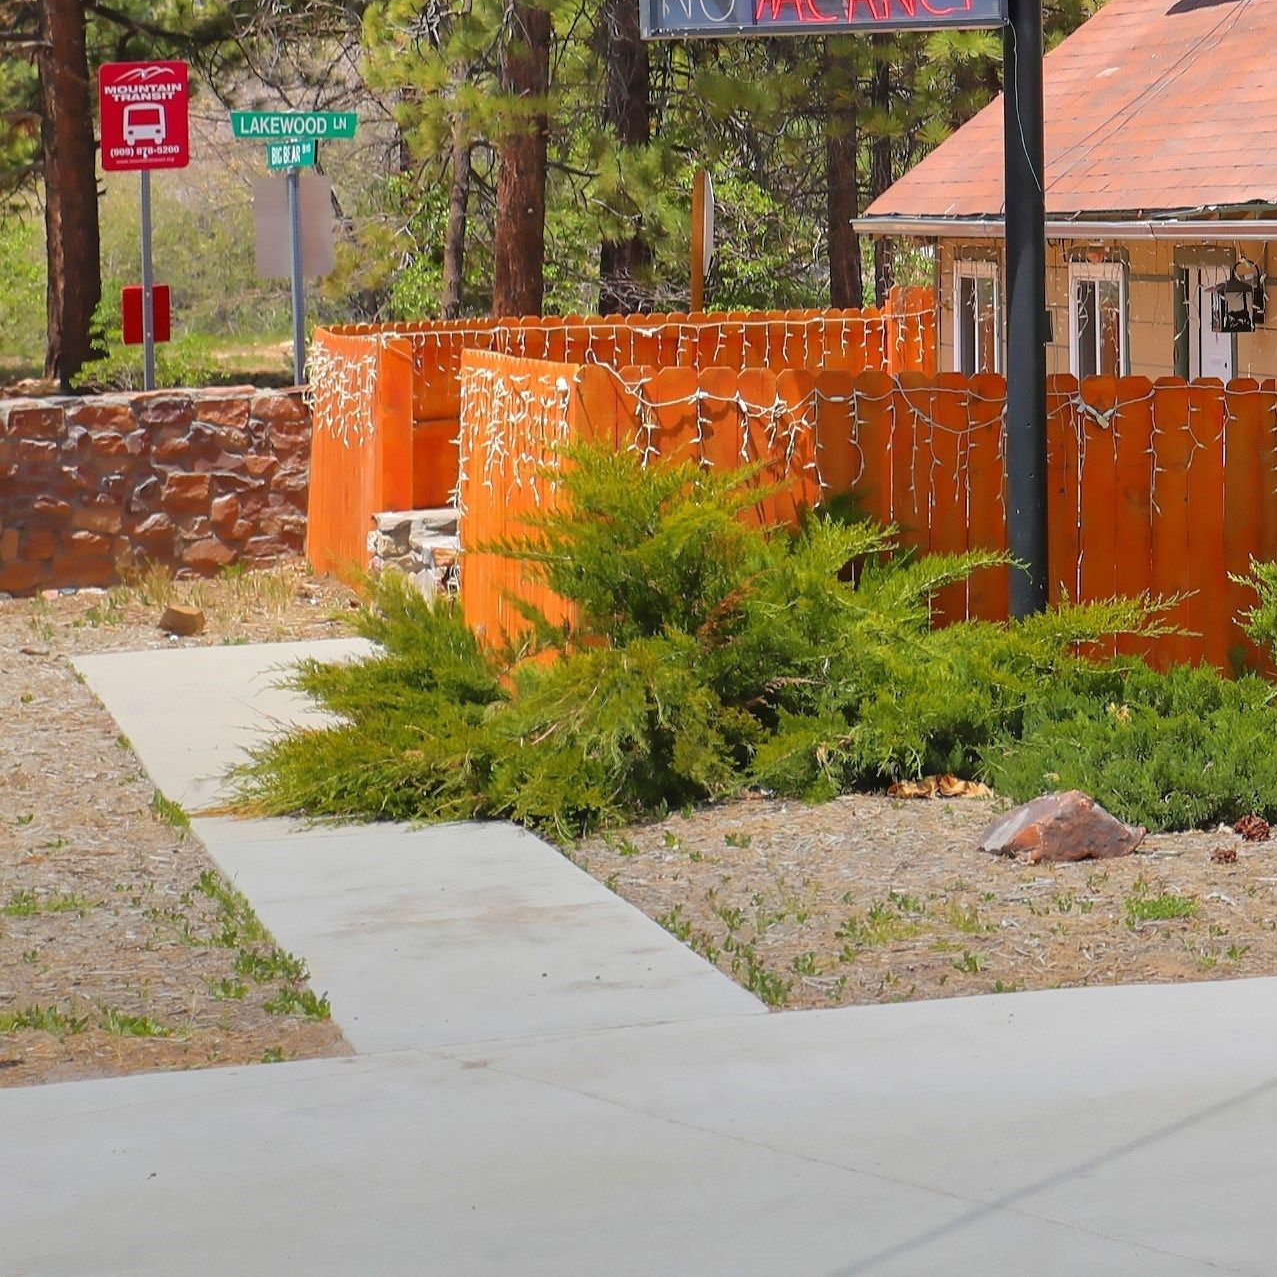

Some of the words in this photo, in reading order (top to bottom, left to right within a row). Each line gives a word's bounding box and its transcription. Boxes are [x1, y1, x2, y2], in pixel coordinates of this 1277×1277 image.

[104, 83, 182, 94] MOUNTAIN
[111, 92, 176, 102] TRANSIT
[240, 116, 328, 134] LAKEWOOD
[333, 117, 347, 130] LN
[271, 145, 283, 166] BIG
[283, 143, 302, 165] BEAR
